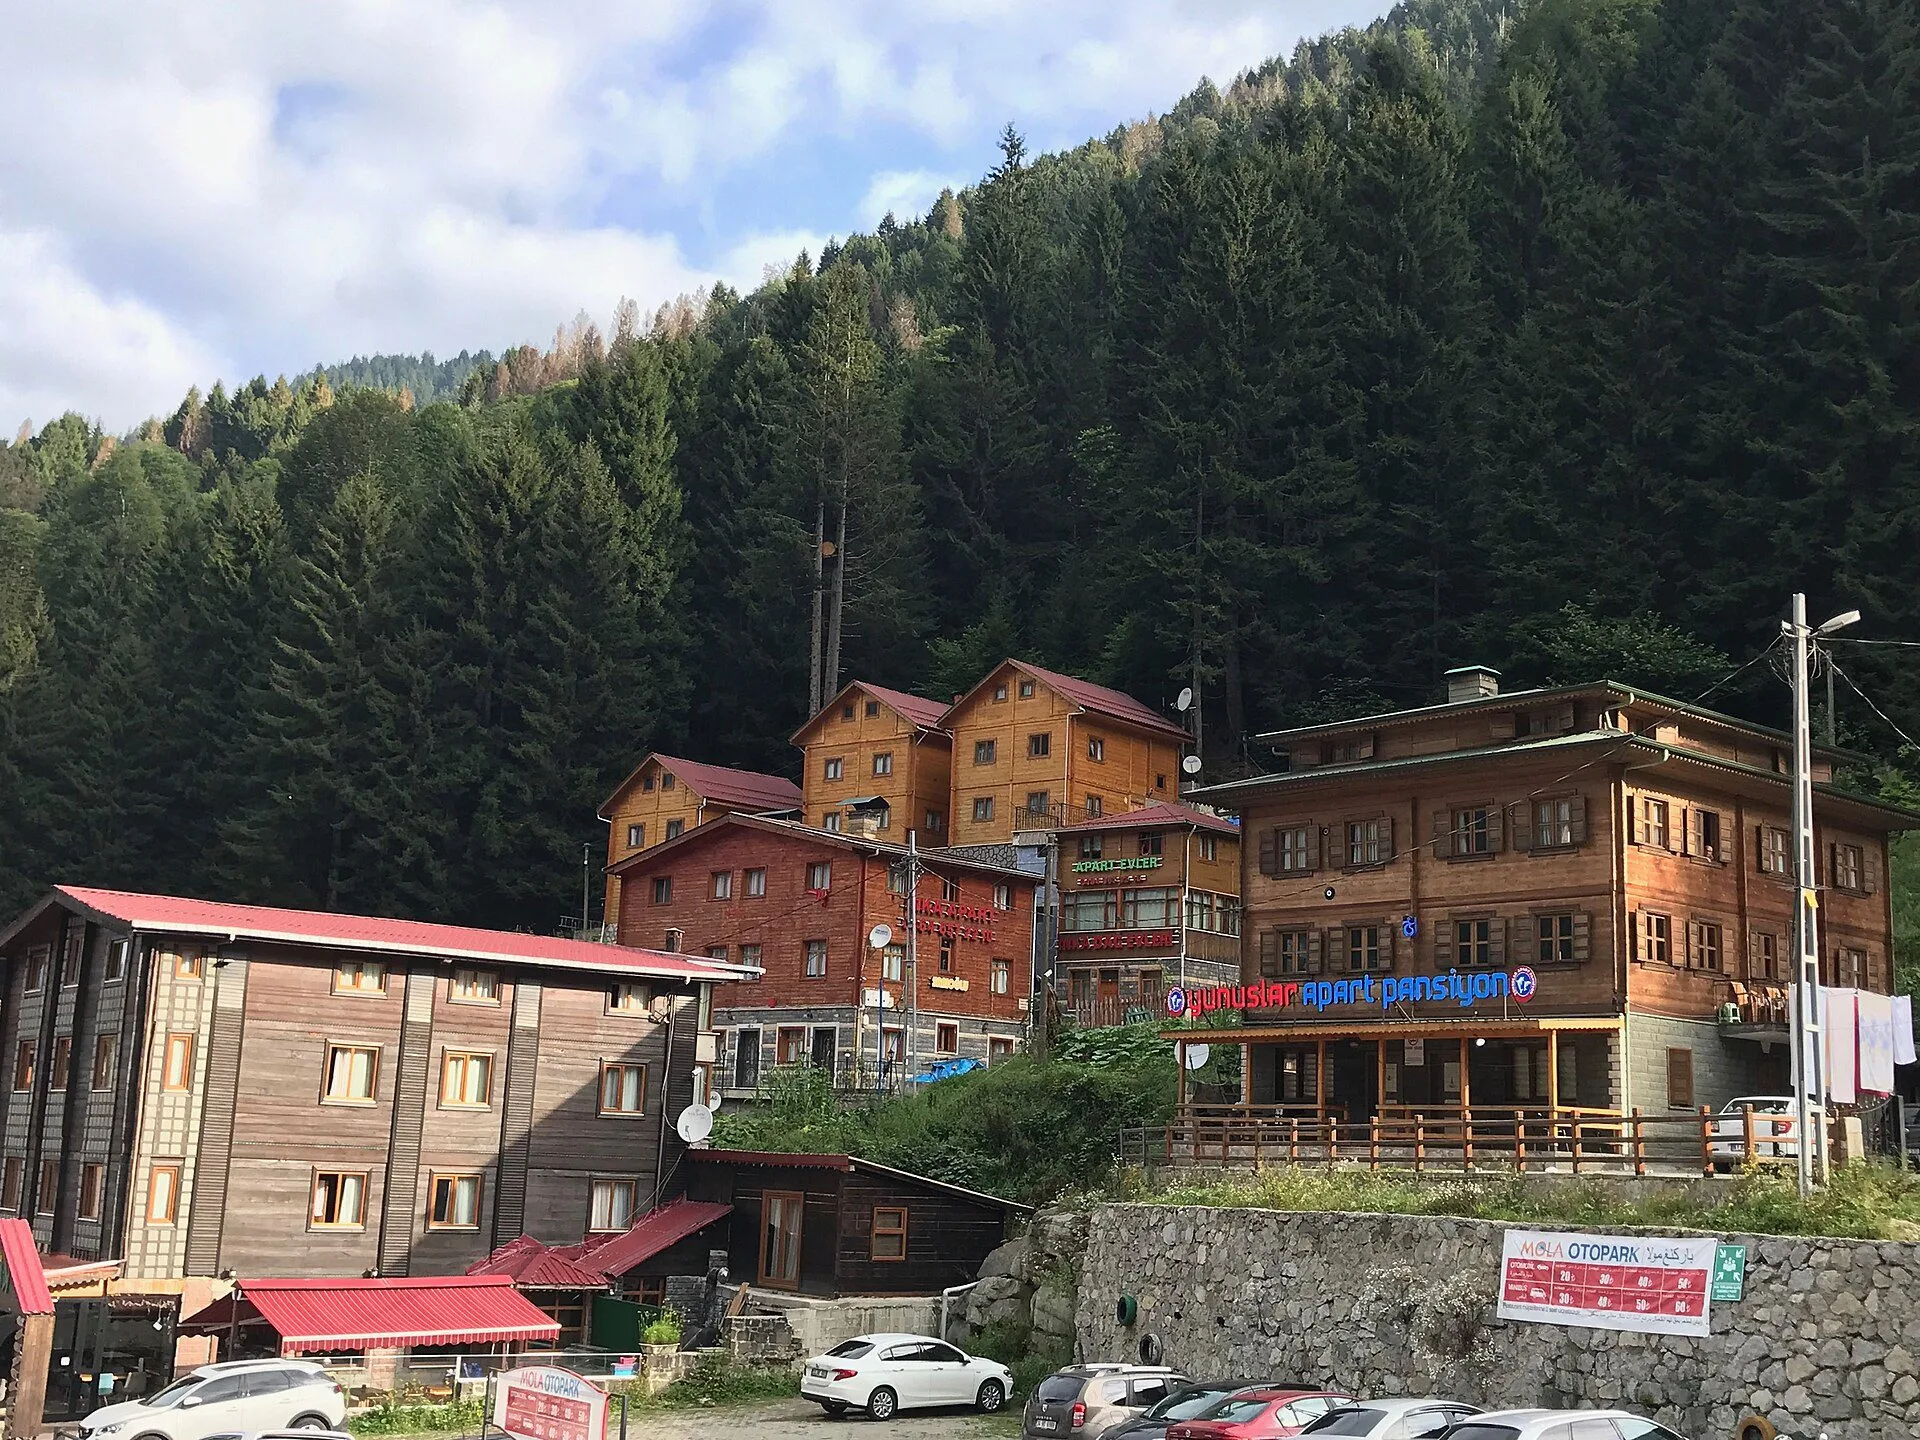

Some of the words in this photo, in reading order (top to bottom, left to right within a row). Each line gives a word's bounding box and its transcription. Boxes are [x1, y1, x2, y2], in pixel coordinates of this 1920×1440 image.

[1075, 860, 1114, 873] APART
[1120, 857, 1158, 870] EVLER
[1187, 980, 1298, 1016] yunuslar
[1303, 974, 1375, 1012] apart
[1382, 968, 1509, 1010] pansiyon
[1521, 1240, 1565, 1259] MOLA
[1567, 1242, 1639, 1263] OTOPARK
[520, 1371, 543, 1389] MOLA
[544, 1374, 581, 1398] OTOPARK
